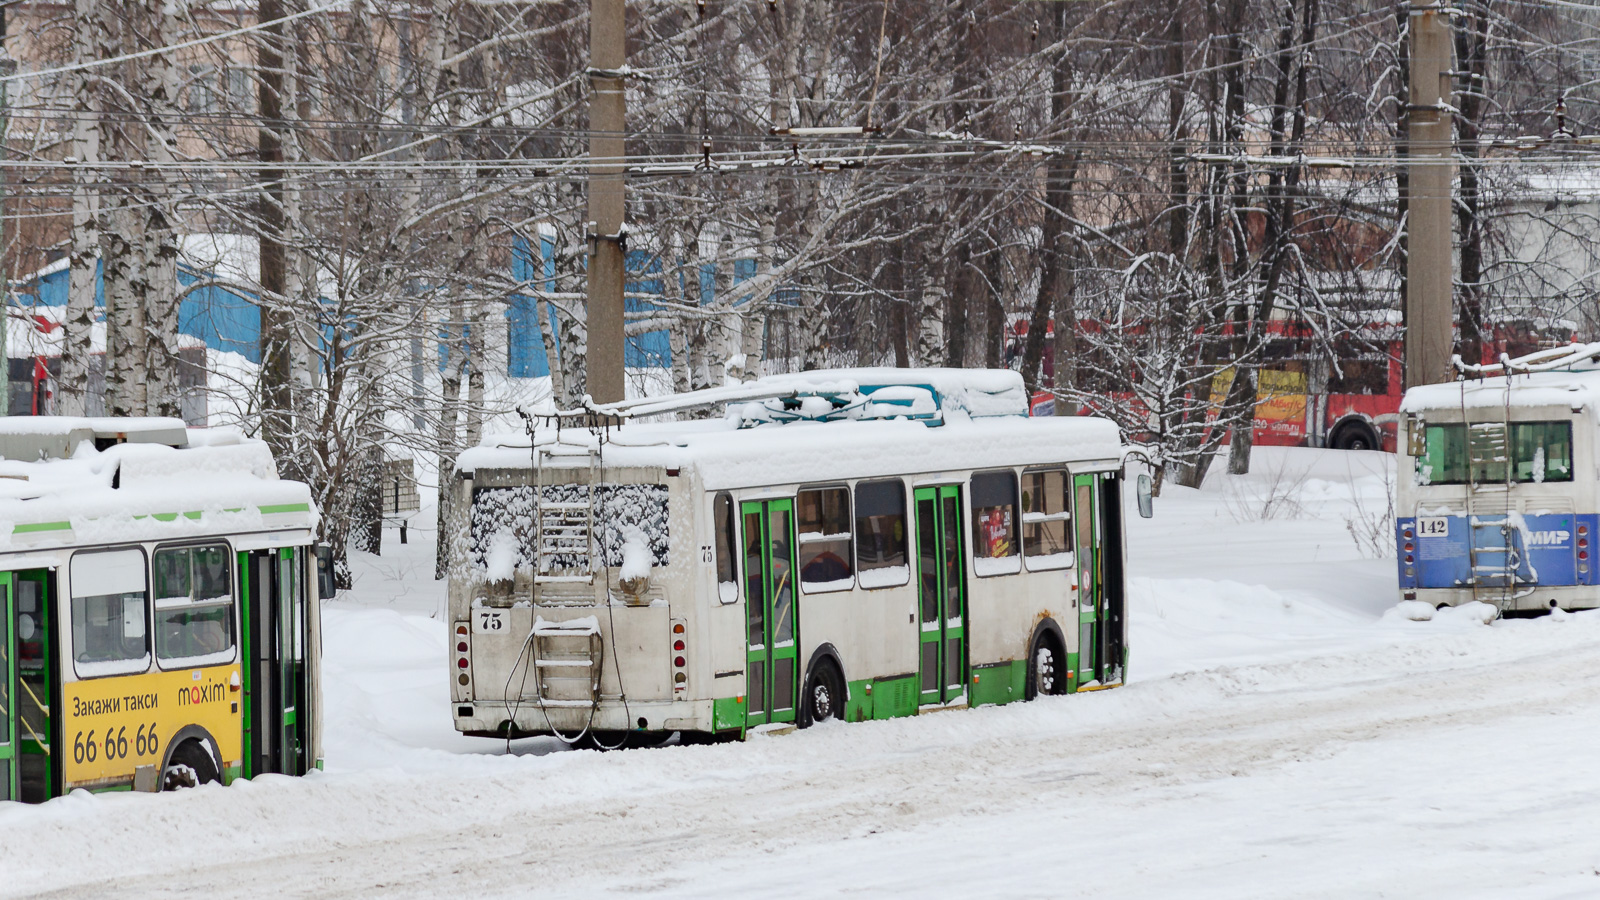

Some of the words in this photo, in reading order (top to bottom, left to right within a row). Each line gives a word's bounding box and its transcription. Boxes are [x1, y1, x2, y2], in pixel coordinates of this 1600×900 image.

[1420, 520, 1446, 534] 142
[1527, 530, 1570, 545] МИР
[701, 545, 713, 563] 75
[480, 612, 502, 630] 75
[178, 678, 225, 706] maxim
[73, 696, 121, 717] Закажи
[123, 693, 158, 712] такси
